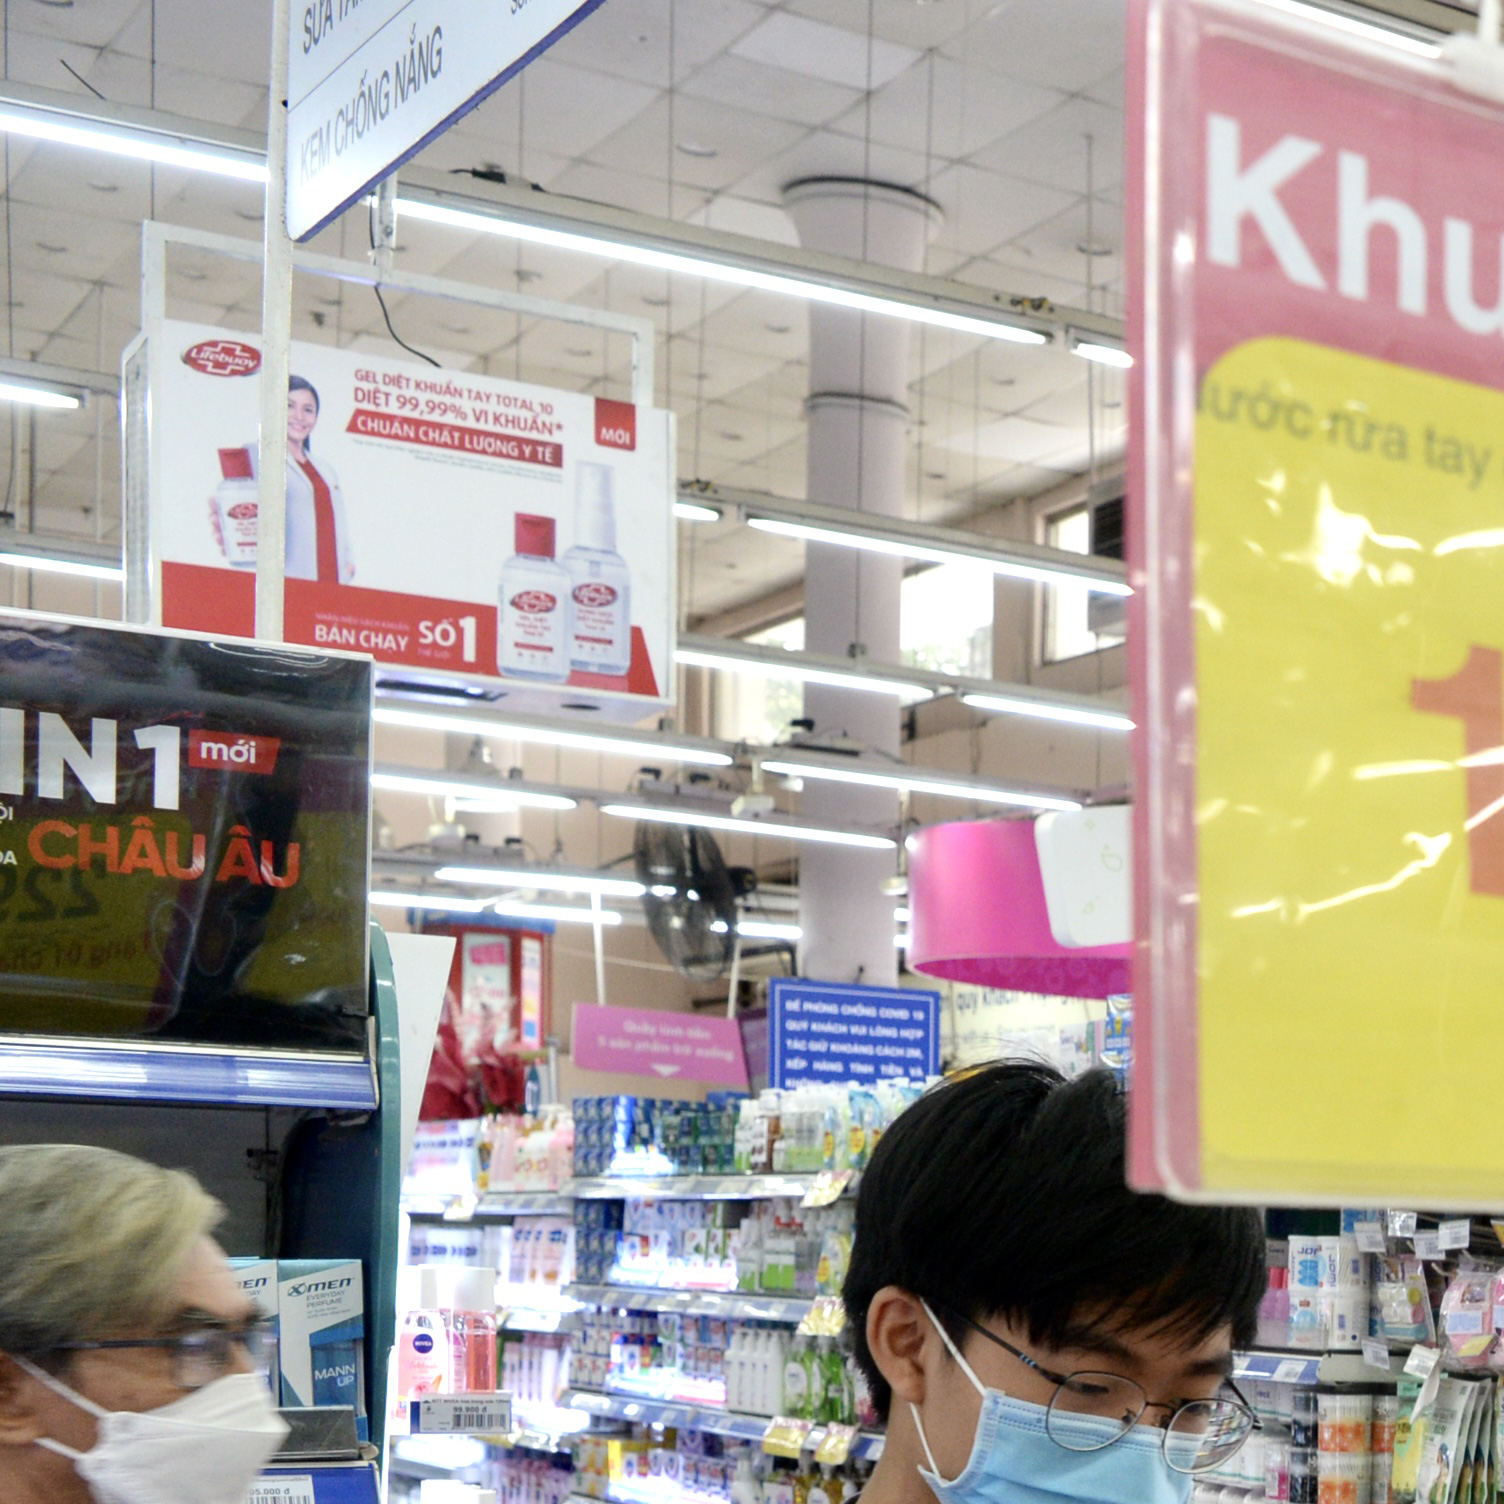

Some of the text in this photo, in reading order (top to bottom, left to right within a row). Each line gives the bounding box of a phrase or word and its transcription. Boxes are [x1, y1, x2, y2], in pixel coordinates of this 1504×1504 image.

[300, 23, 443, 187] KEM CHỐNG NẮNG
[190, 347, 257, 369] Lifebuoy
[354, 369, 379, 385] GEL
[382, 372, 412, 392] DIỆT
[466, 388, 492, 403] TAY
[495, 392, 536, 412] TOTAL
[540, 402, 553, 416] 10
[354, 386, 392, 409] DIỆT
[396, 394, 468, 421] 99,99%
[472, 408, 490, 425] VI
[356, 415, 415, 439] CHUẨN
[419, 425, 461, 447] CHẤT
[464, 432, 519, 458] LƯỢNG
[522, 445, 535, 459] Y
[535, 443, 555, 463] TẾ
[600, 424, 631, 446] MỚI
[1424, 425, 1492, 491] tay
[314, 623, 355, 646] BÁN
[359, 630, 409, 653] CHẠY
[418, 617, 457, 647] SỐ
[459, 616, 477, 663] 1
[200, 738, 256, 764] mới
[28, 816, 205, 880] CHÂU
[217, 825, 300, 888] ÂU
[306, 1290, 345, 1302] EVERYDAY
[306, 1298, 343, 1309] PERFUME
[314, 1364, 355, 1380] MANN
[336, 1375, 354, 1388] UP
[246, 1488, 281, 1496] 05.000
